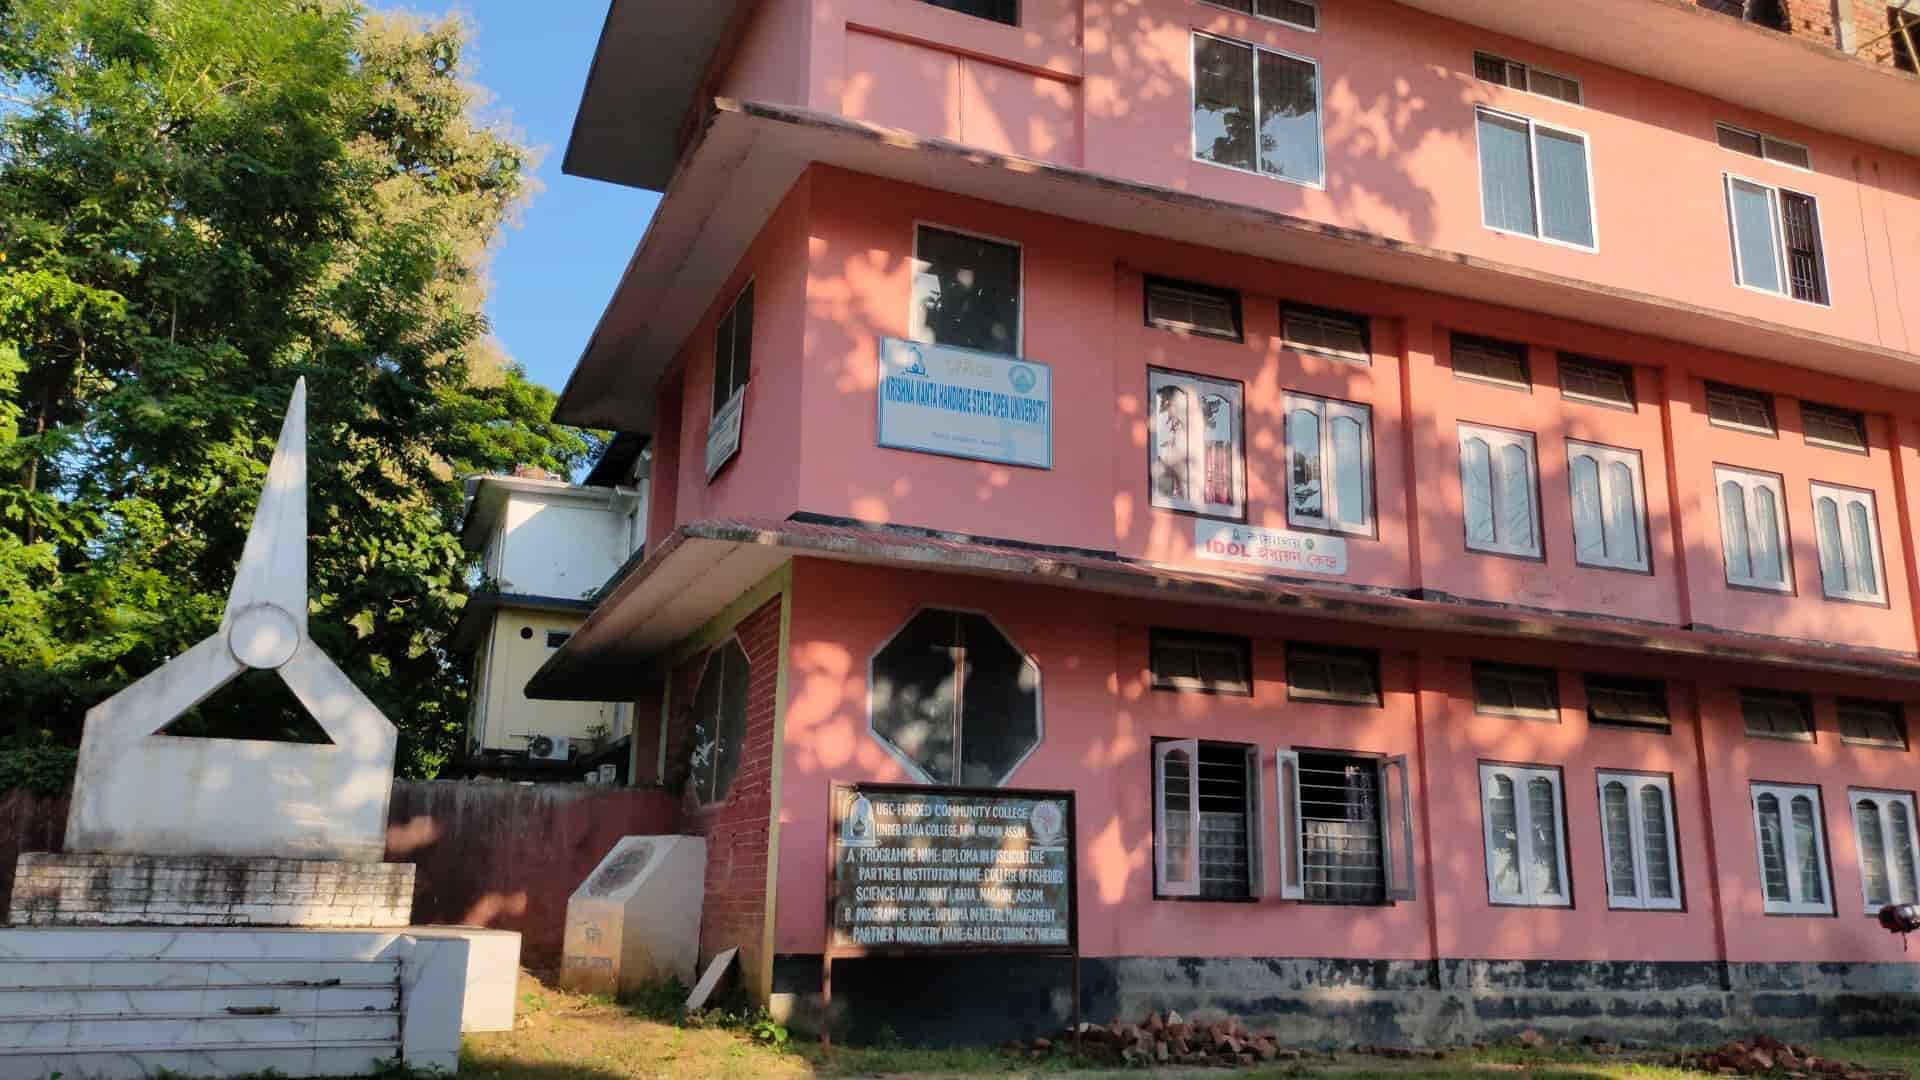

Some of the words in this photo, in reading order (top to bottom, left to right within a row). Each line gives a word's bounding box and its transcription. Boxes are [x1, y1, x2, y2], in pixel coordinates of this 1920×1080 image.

[972, 390, 991, 416] STATE
[993, 392, 1009, 418] OPEN
[1010, 397, 1047, 424] UNIVERSITY
[1205, 539, 1250, 558] IDOL
[876, 802, 931, 817] UGC-FUNDED
[934, 803, 992, 818] COMMUNITY
[992, 807, 1028, 819] COLLEGE
[876, 823, 900, 836] UNDER
[902, 823, 924, 837] RAHA
[1005, 825, 1027, 838] ASSAM
[860, 848, 915, 863] PROGRAMME
[860, 867, 900, 881] PARTNER
[903, 867, 957, 881] INSTITUTION
[984, 868, 1016, 882] COLLEGE
[1016, 889, 1044, 902] ASSAM
[856, 908, 907, 922] PROGRAMME
[1007, 908, 1056, 922] MANAGEMENT
[853, 927, 895, 943] PARTNER
[897, 927, 942, 943] INDUSTRY
